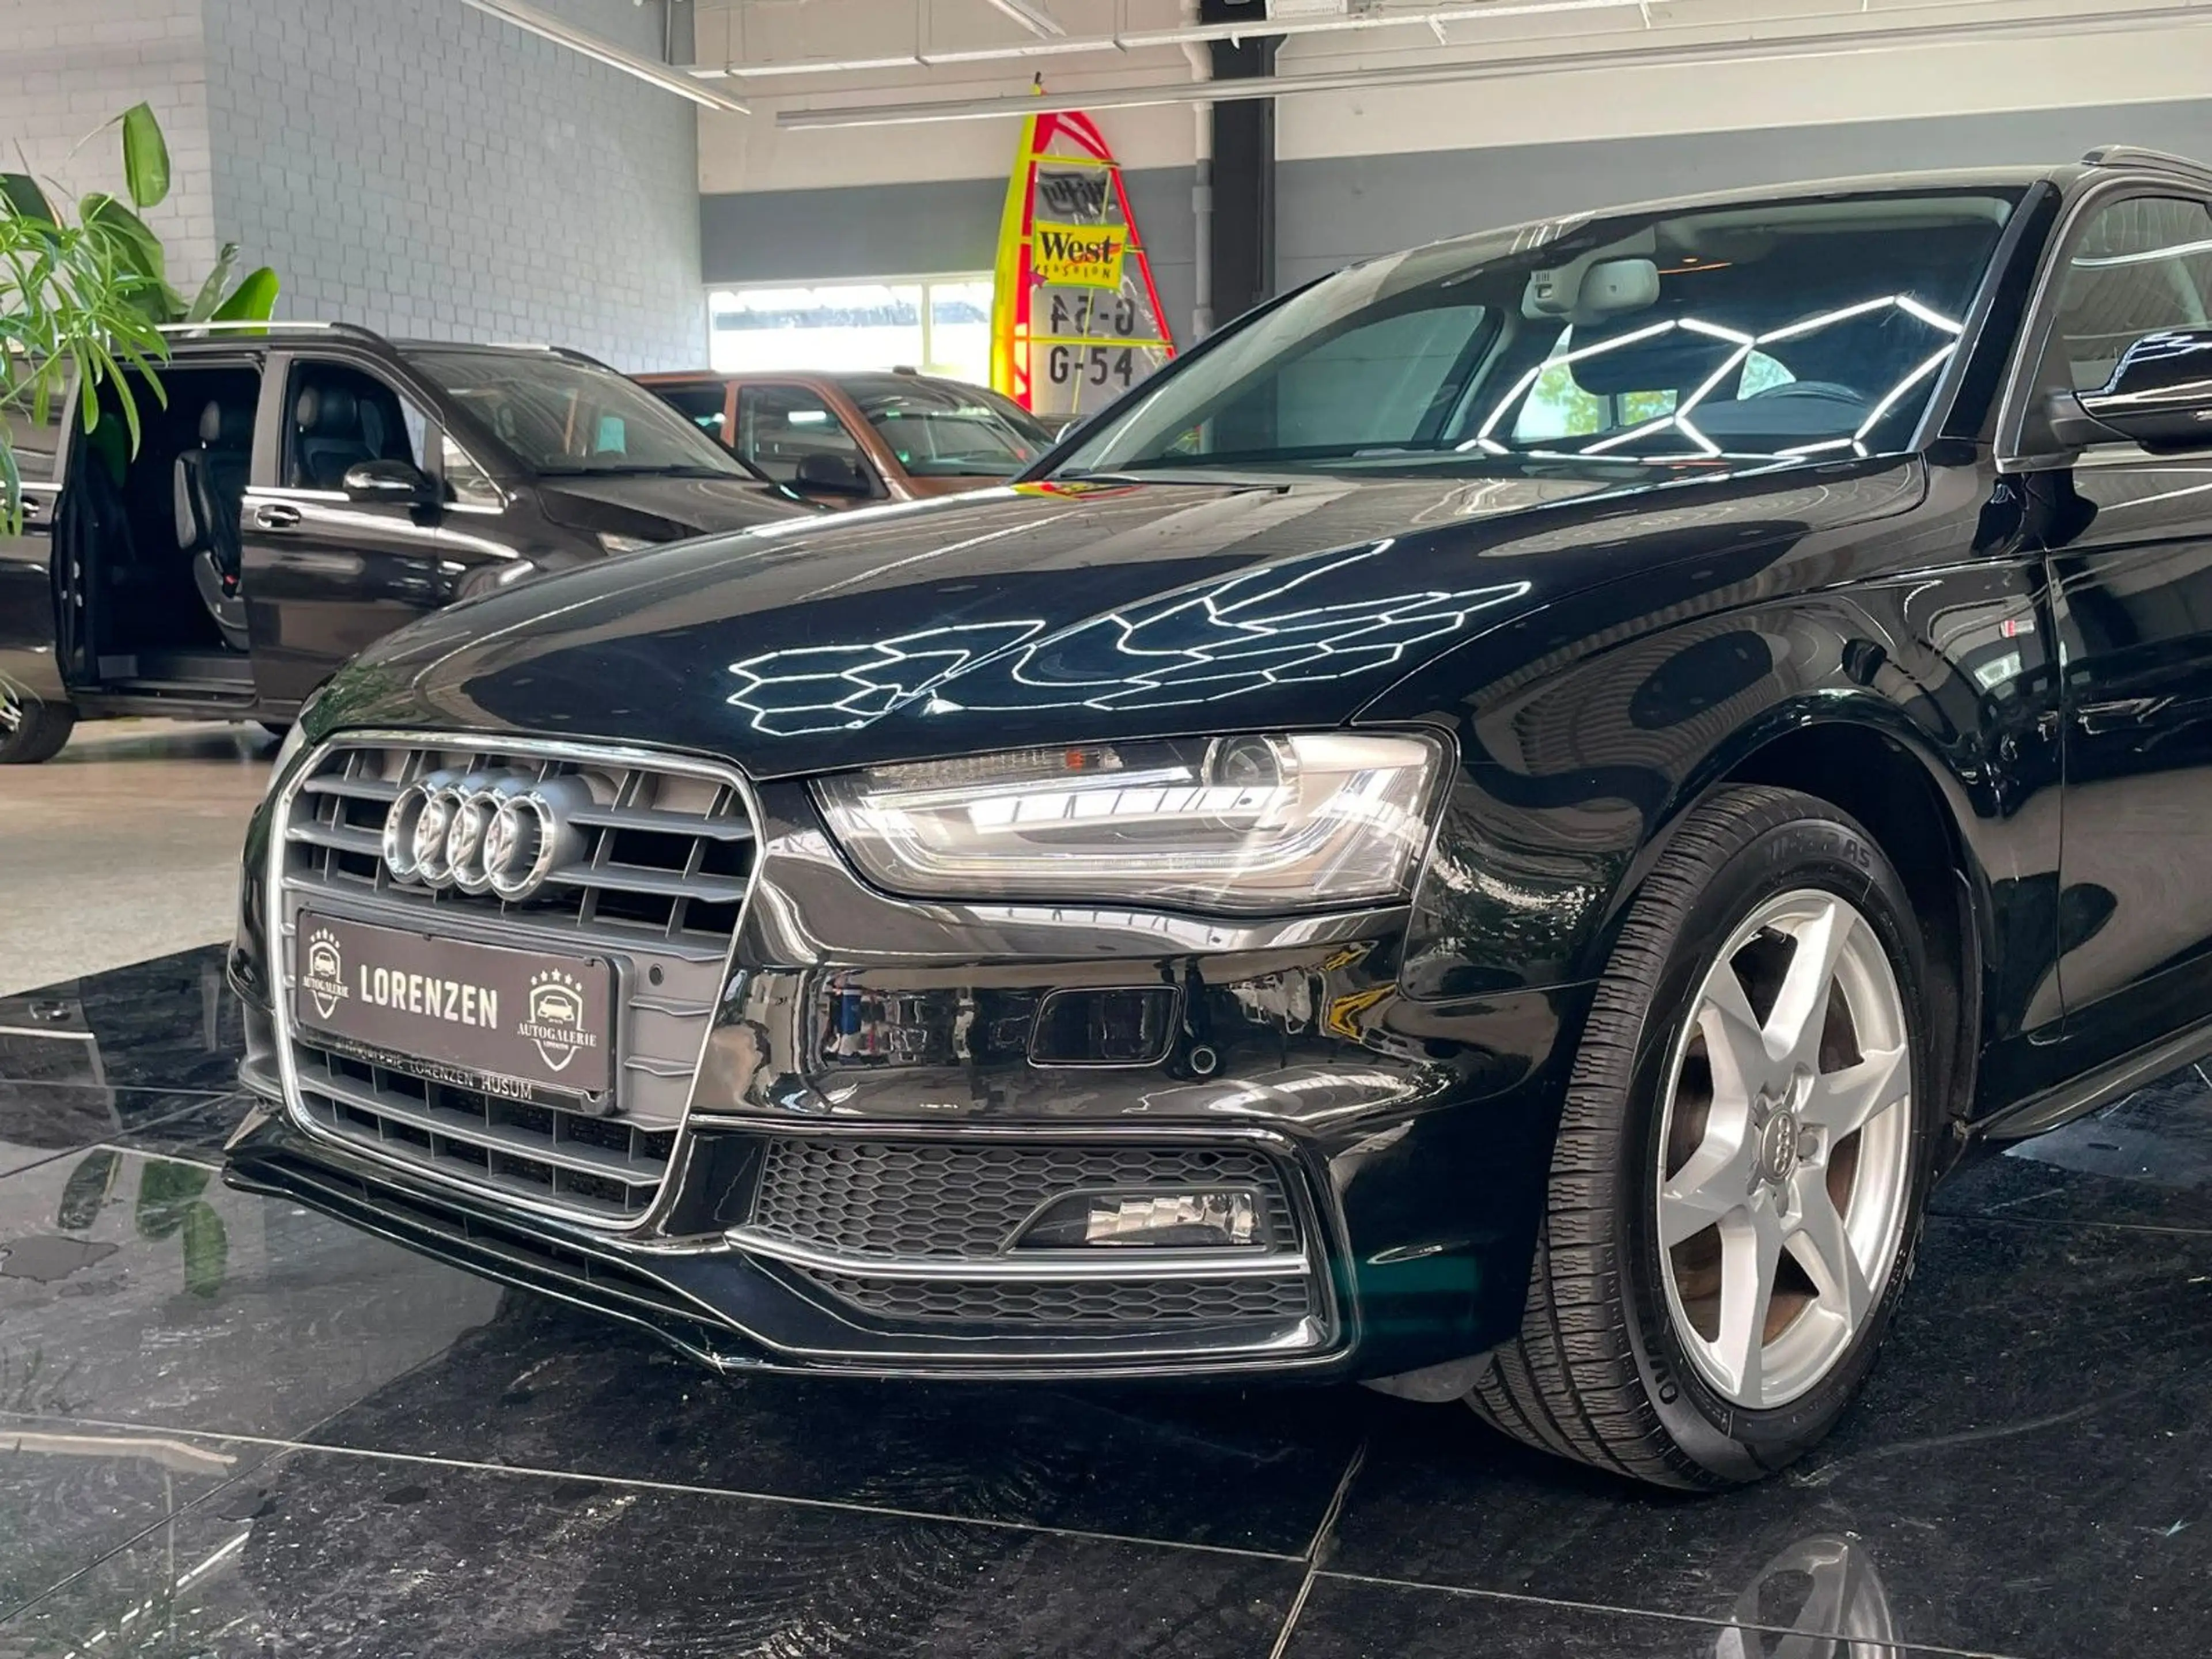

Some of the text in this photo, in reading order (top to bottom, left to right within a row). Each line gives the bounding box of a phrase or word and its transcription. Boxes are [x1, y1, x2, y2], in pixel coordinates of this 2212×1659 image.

[1040, 231, 1113, 264] West
[1050, 346, 1133, 387] G-54
[361, 964, 498, 1030] LORENZEN
[517, 1022, 597, 1047] AUTOGALERIE
[410, 1060, 474, 1088] LORENZEN
[480, 1074, 532, 1100] HUSUM
